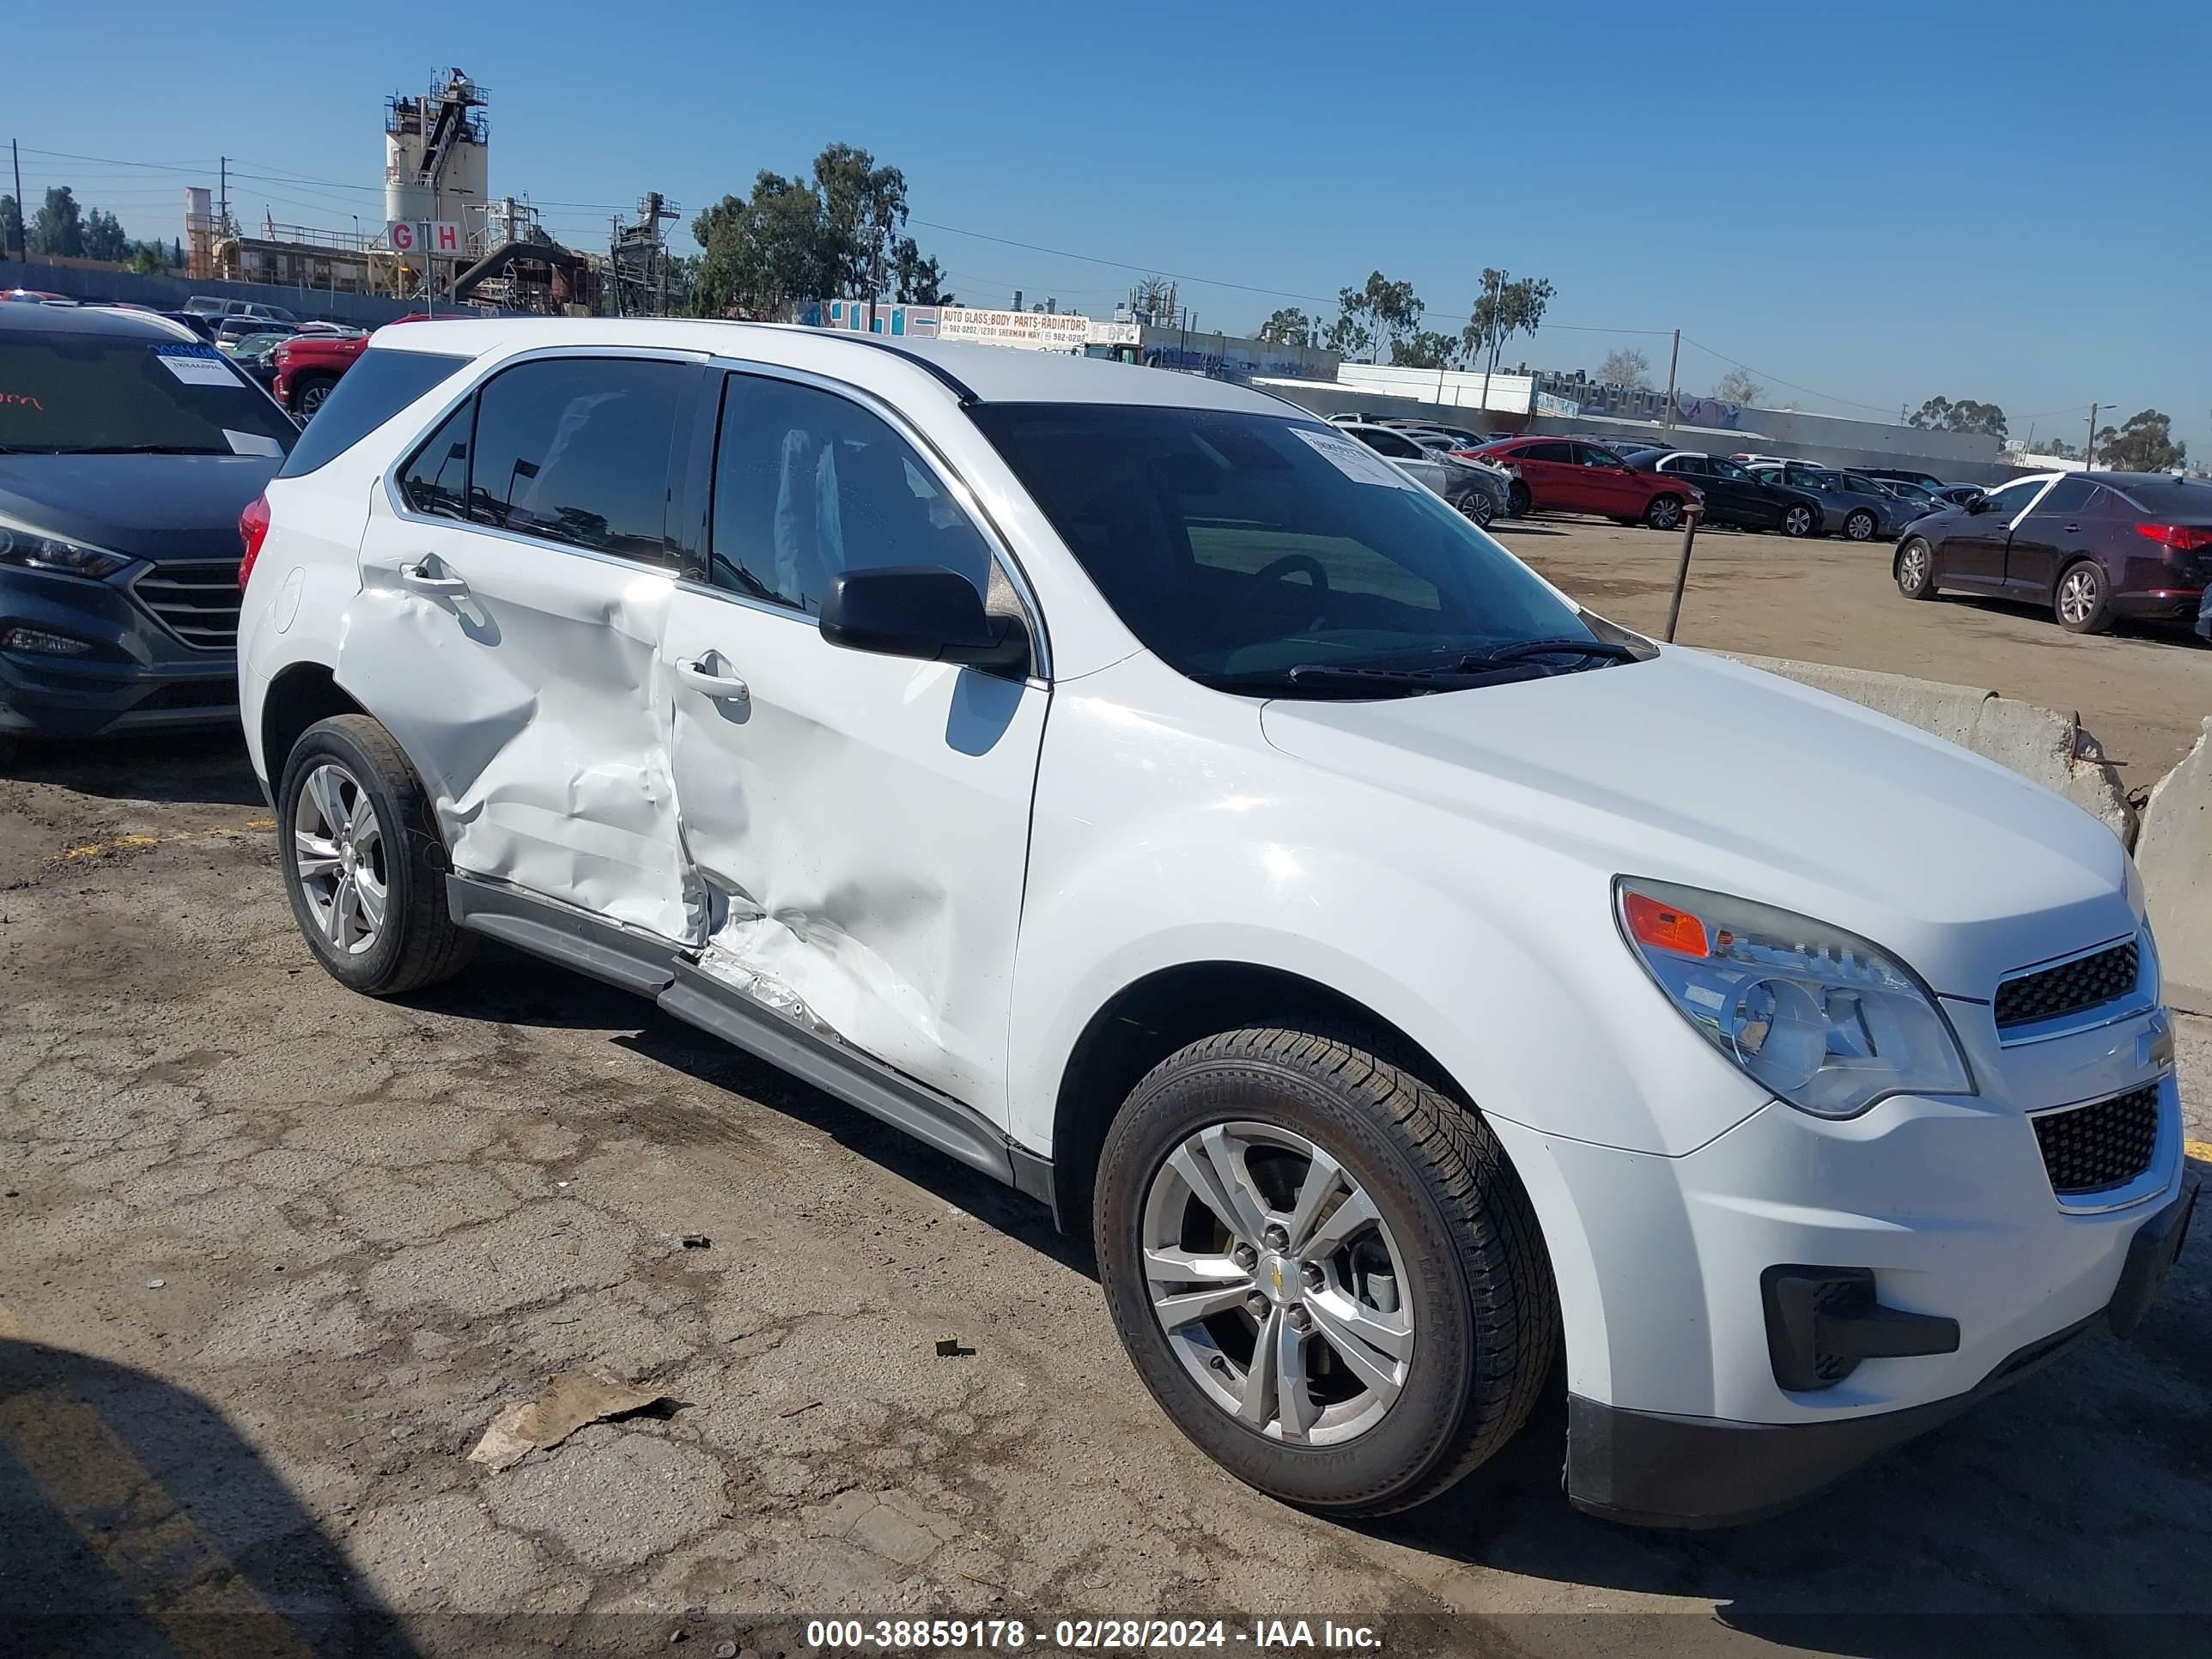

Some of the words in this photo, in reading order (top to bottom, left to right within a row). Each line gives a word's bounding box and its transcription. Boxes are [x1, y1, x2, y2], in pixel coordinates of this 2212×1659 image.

[393, 223, 412, 249] G
[439, 225, 457, 250] H
[943, 310, 963, 323] AUTO
[998, 328, 1026, 339] SHERMAN
